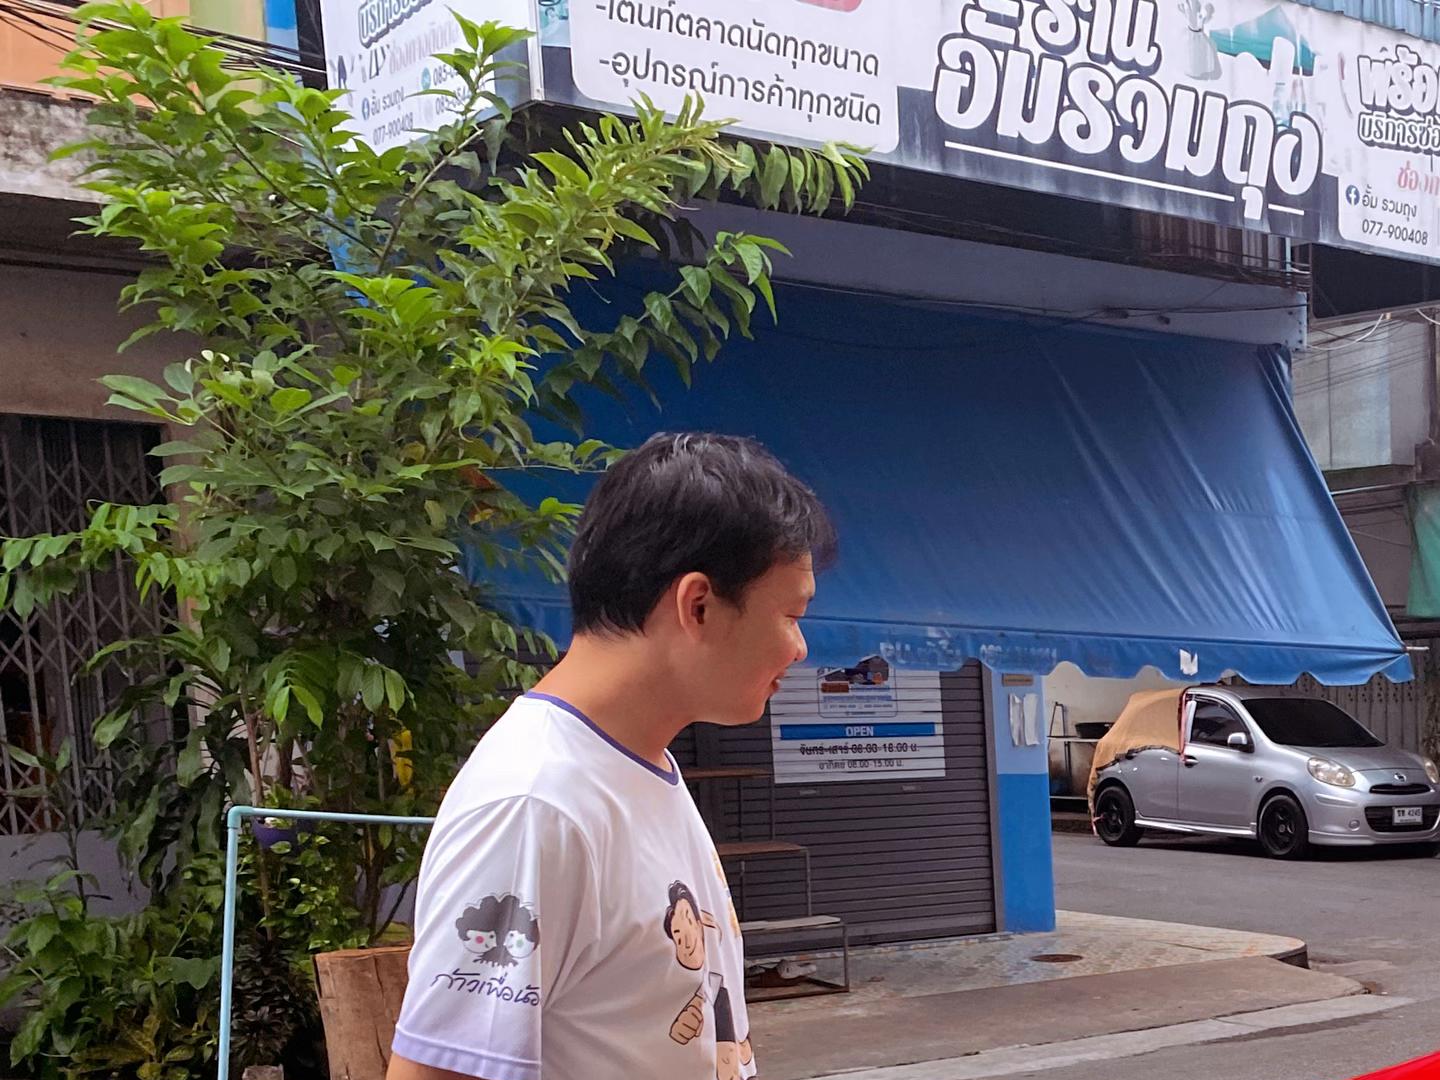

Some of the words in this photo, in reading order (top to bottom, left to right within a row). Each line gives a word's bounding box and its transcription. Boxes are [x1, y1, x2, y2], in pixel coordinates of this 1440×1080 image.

[596, 0, 880, 77] -เตนท์ตลาดนัดทุกขนาด
[1032, 0, 1162, 73] ราน
[599, 47, 882, 126] -อุปกรณ์การค้าทุกชนิด
[1361, 184, 1378, 209] อั้ม
[1382, 198, 1418, 222] รวมถุง
[1361, 218, 1429, 246] 077-900408
[845, 726, 874, 737] OPEN
